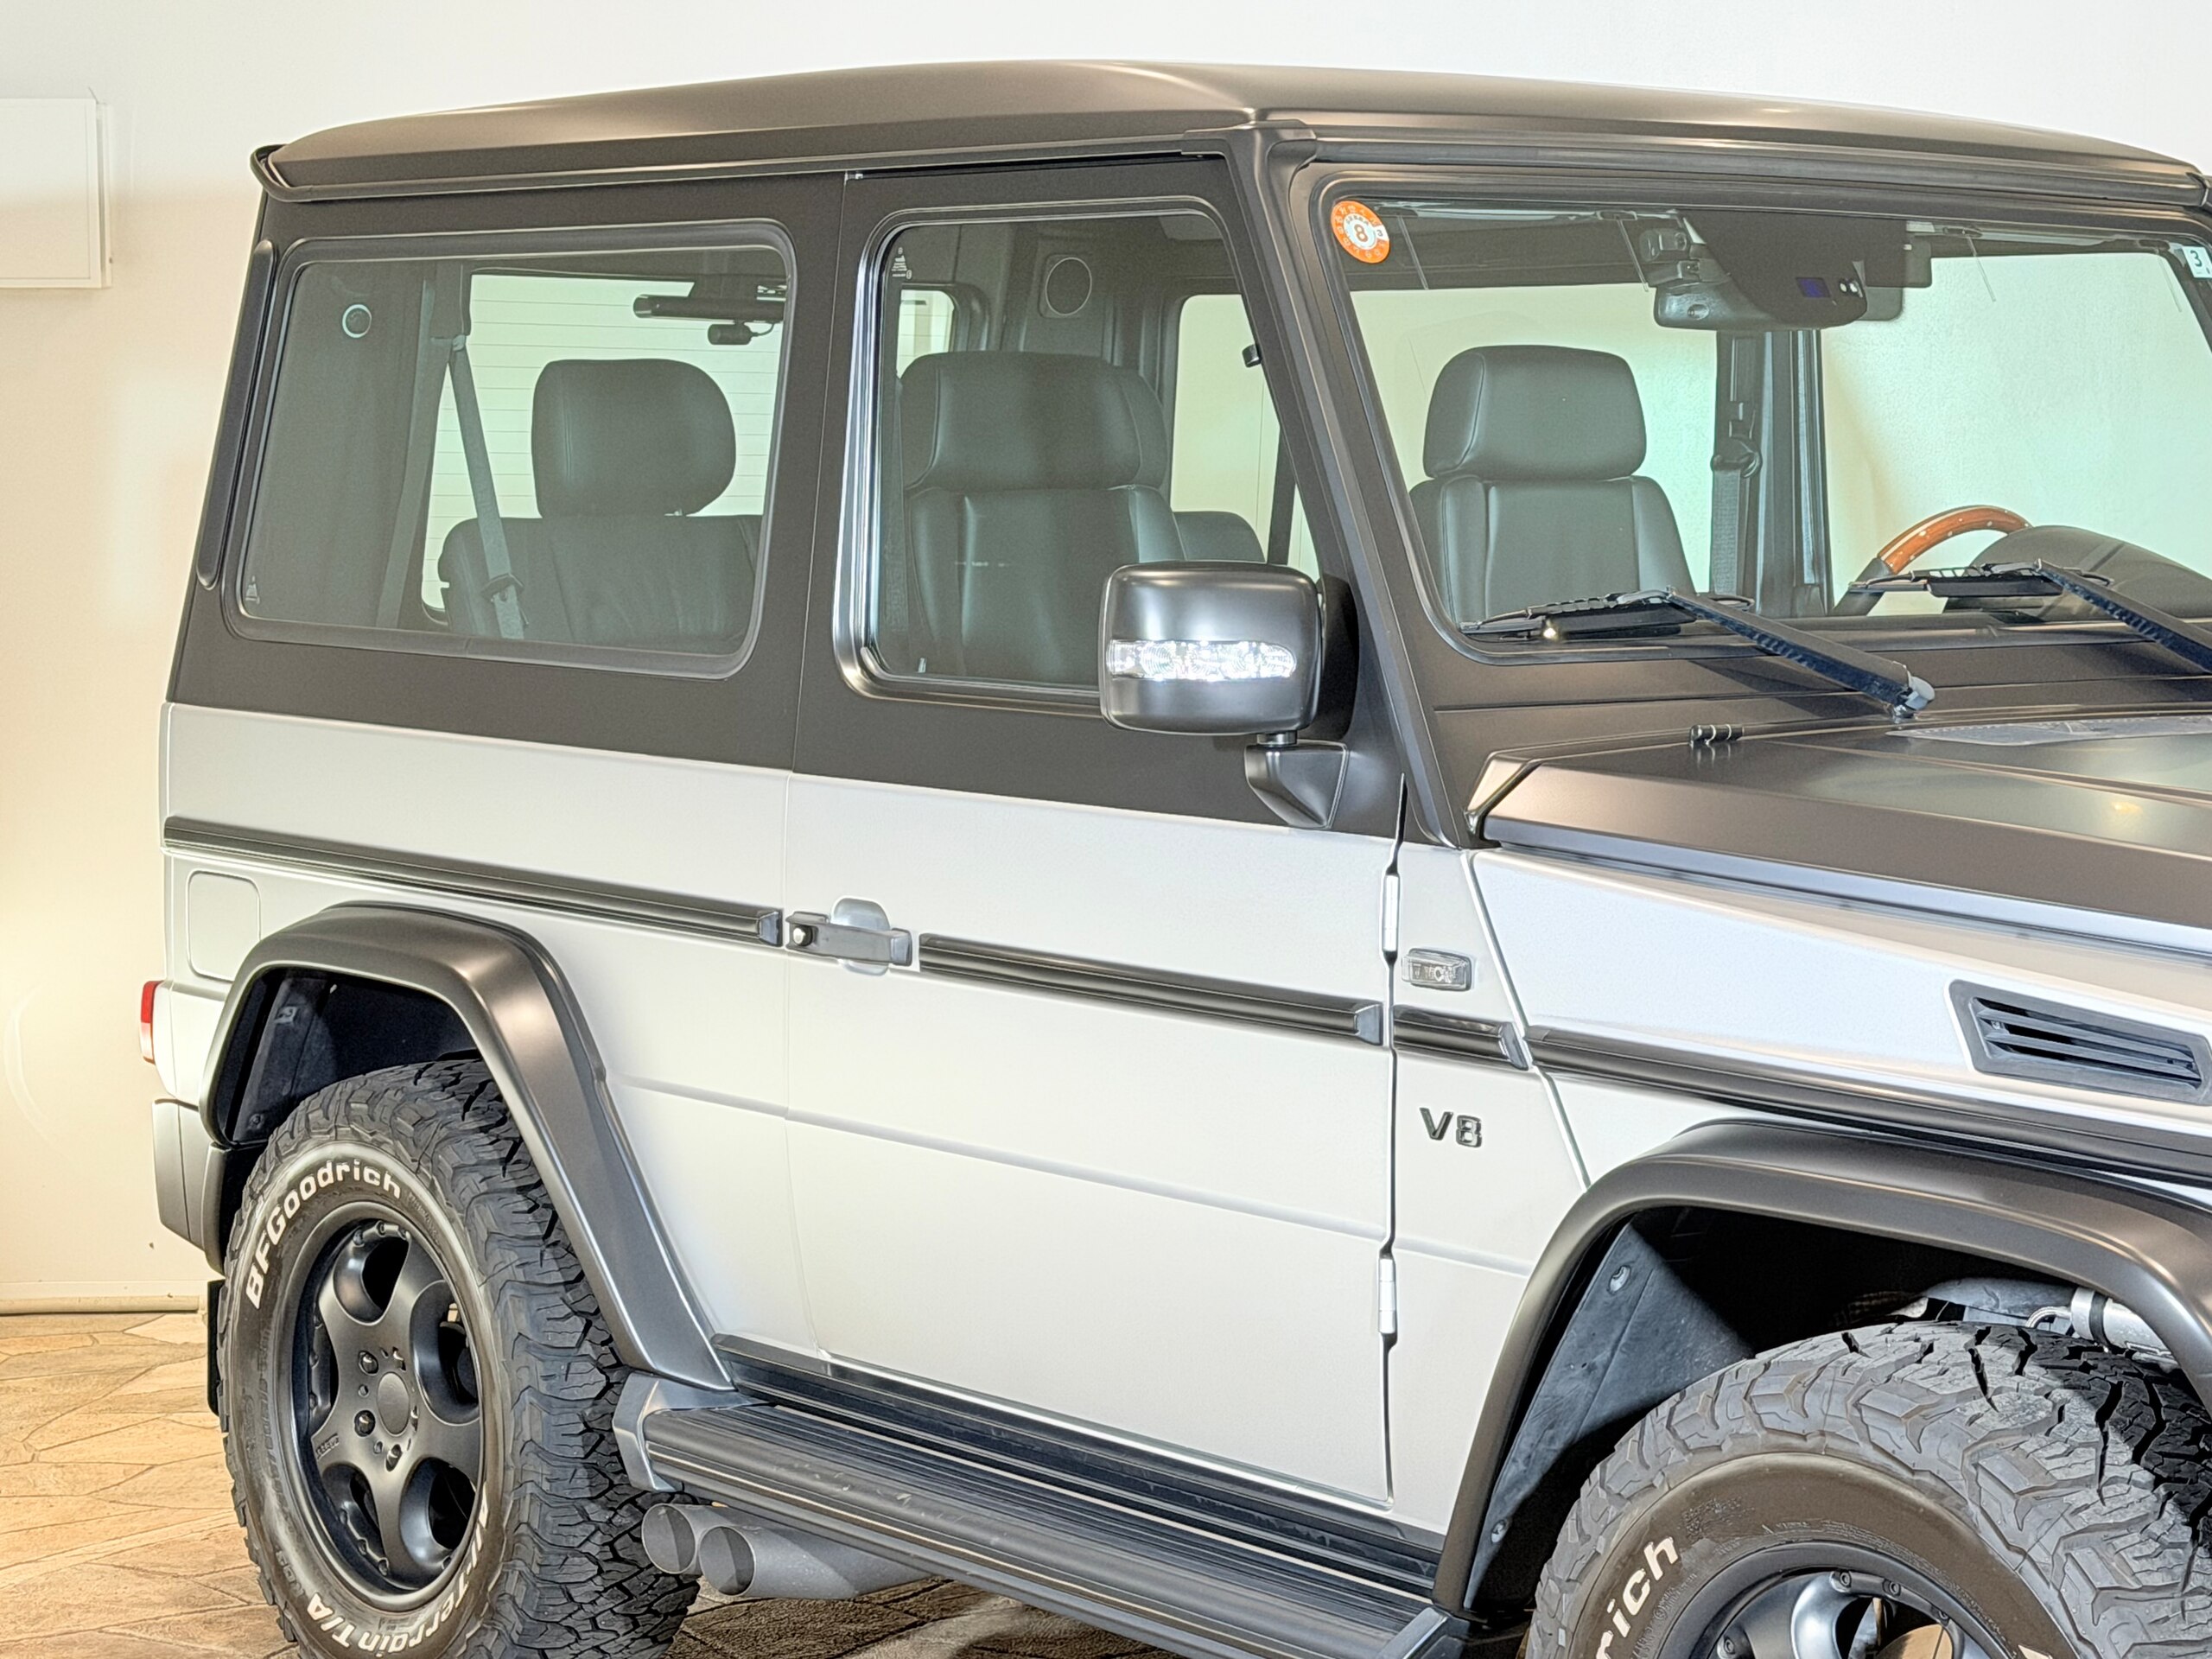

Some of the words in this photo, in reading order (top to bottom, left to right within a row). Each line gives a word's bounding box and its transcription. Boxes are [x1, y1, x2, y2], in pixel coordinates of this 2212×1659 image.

[1353, 224, 1369, 243] 8
[2190, 249, 2202, 267] 3
[1419, 1107, 1483, 1148] V8
[245, 1159, 402, 1310] BFGoodrich
